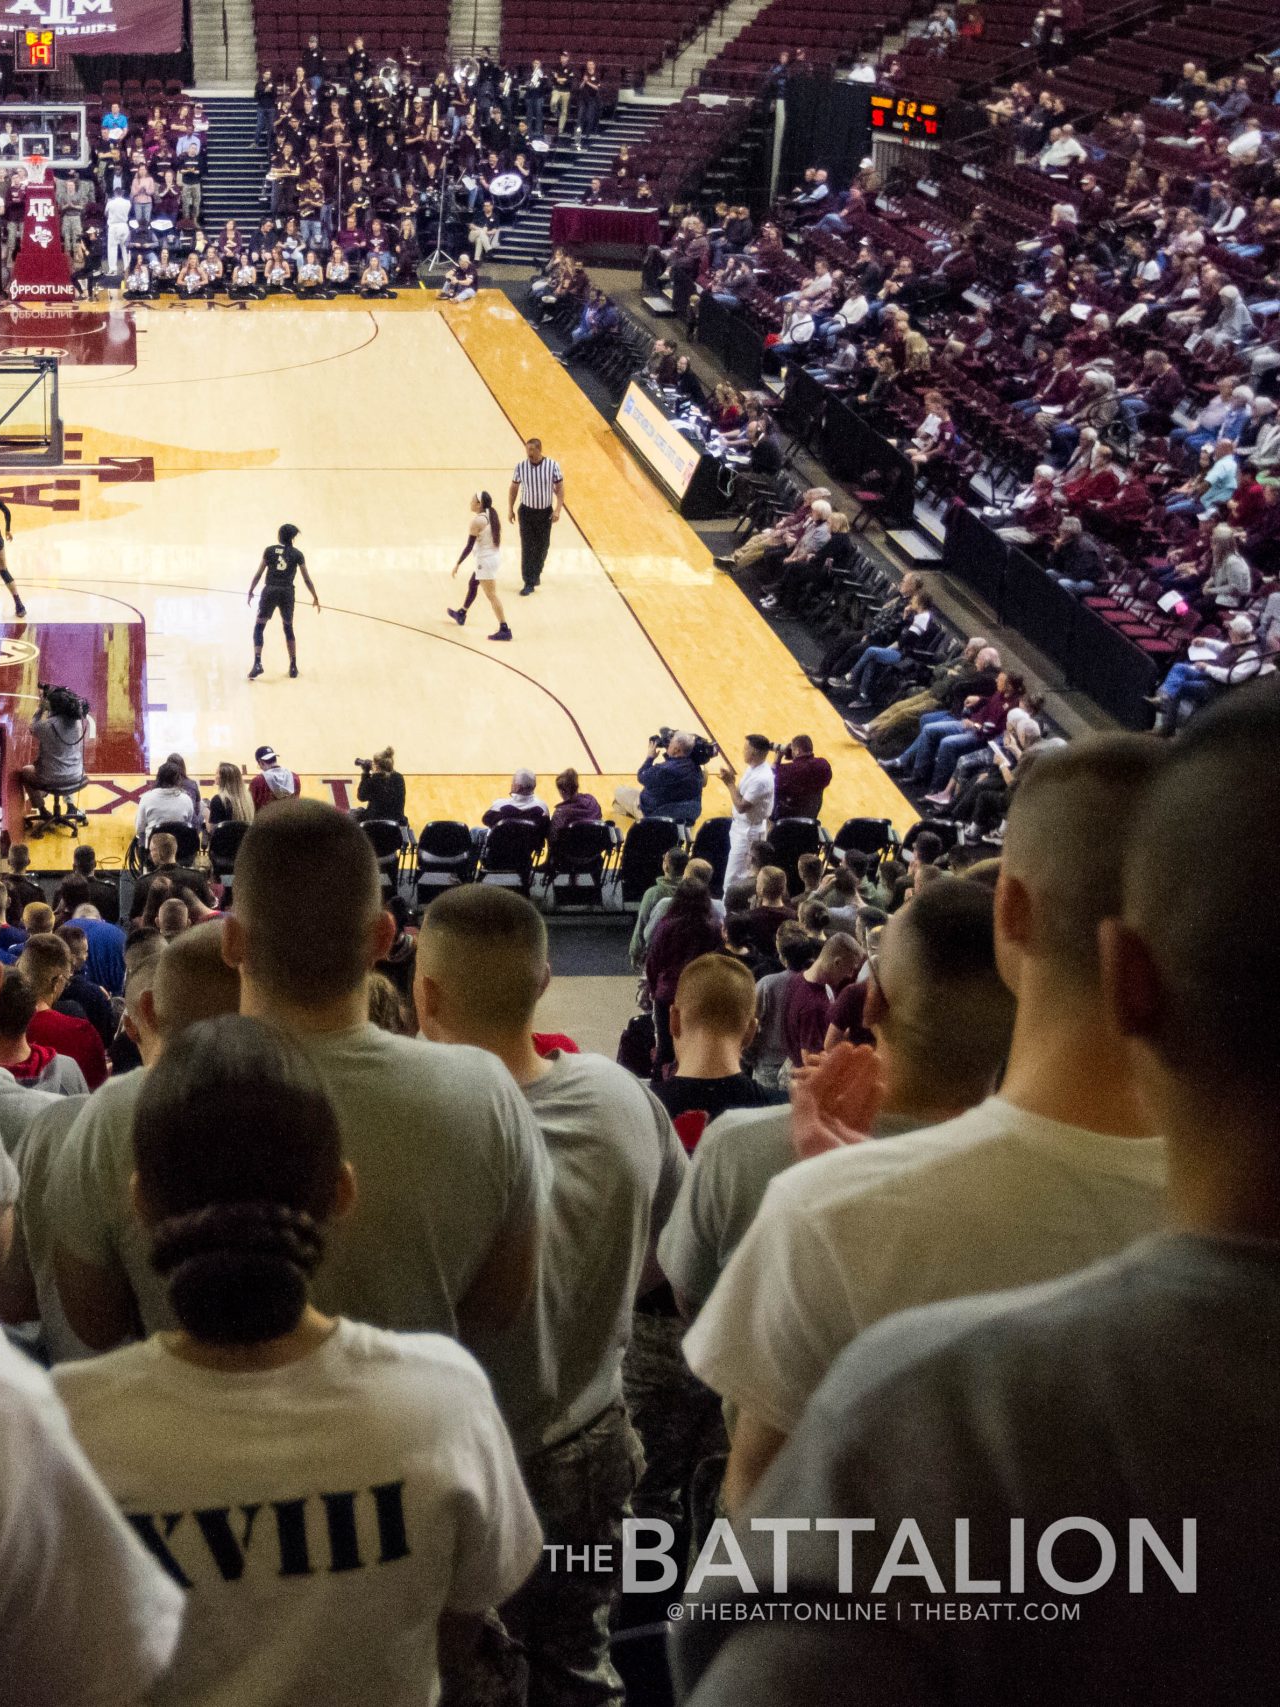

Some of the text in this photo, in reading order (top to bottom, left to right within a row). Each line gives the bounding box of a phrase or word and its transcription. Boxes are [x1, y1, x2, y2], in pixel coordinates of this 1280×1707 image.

[31, 45, 49, 65] 19
[9, 280, 74, 299] OPPORTUNE
[124, 1480, 412, 1589] XVIII
